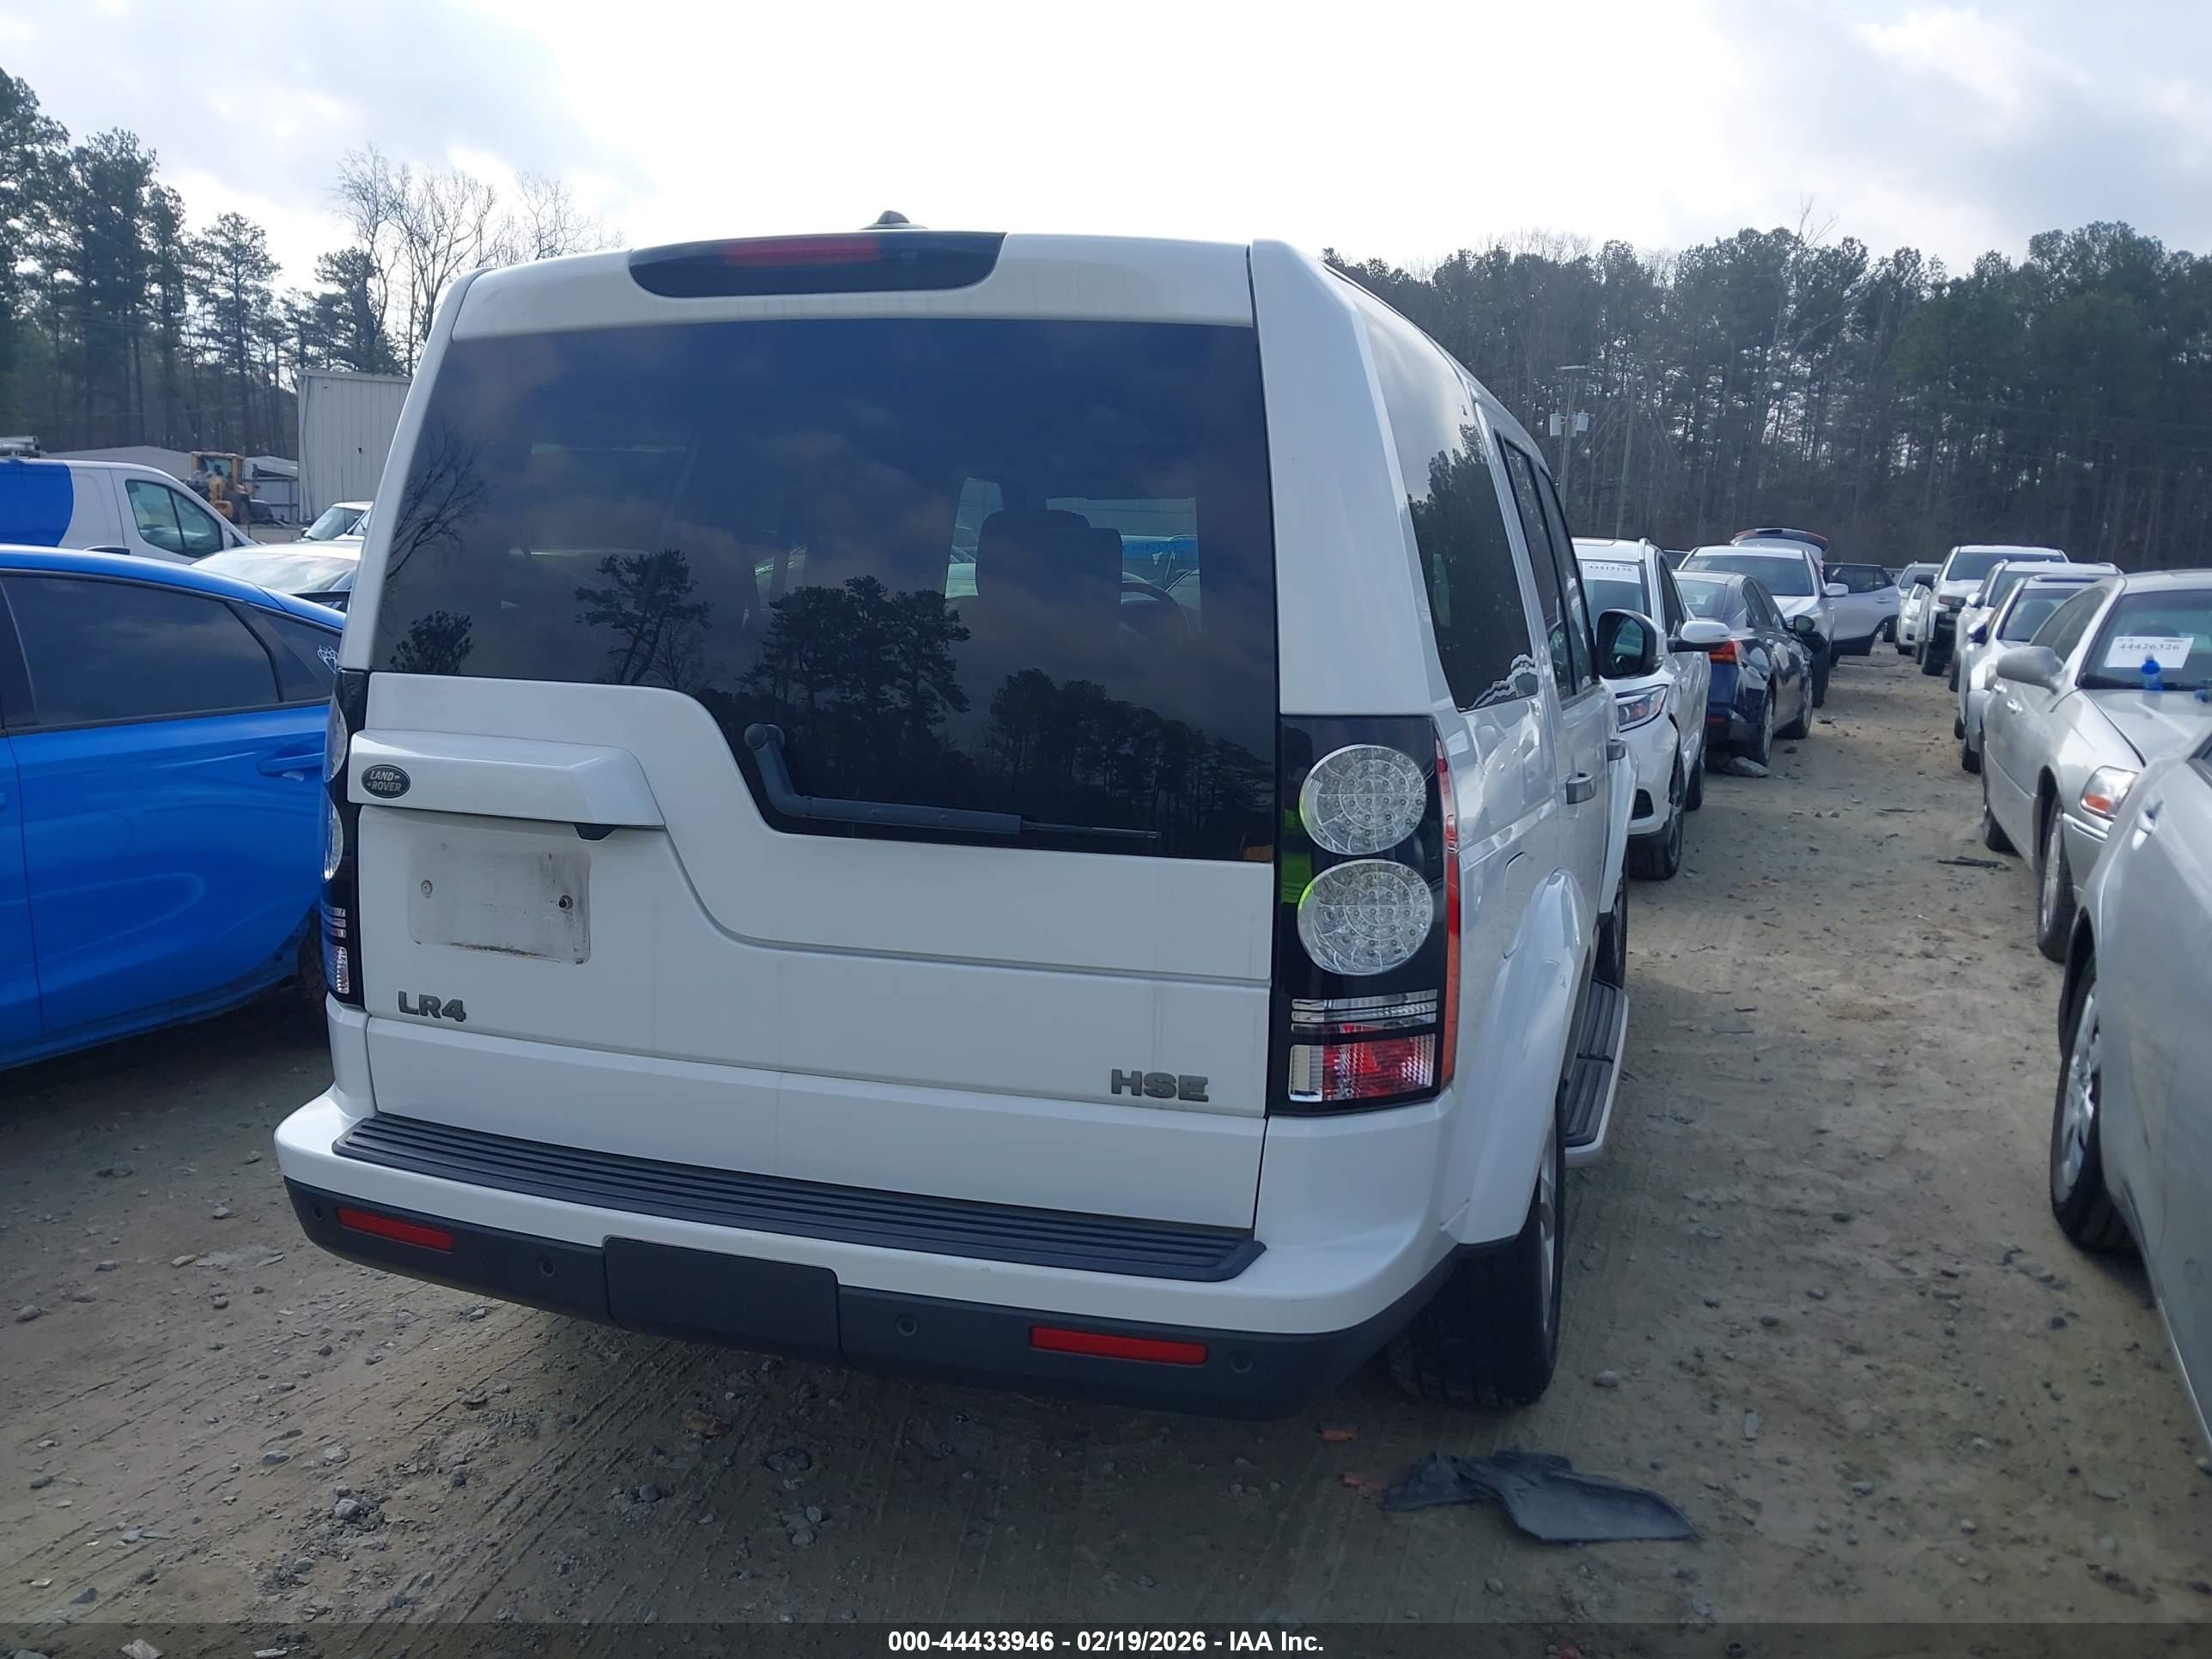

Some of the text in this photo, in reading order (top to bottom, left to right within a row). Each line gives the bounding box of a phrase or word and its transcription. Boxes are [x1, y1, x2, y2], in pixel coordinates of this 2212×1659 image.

[370, 770, 395, 781] LAND
[371, 781, 402, 792] ROVER
[398, 990, 467, 1023] LR4
[1110, 1068, 1210, 1103] HSE
